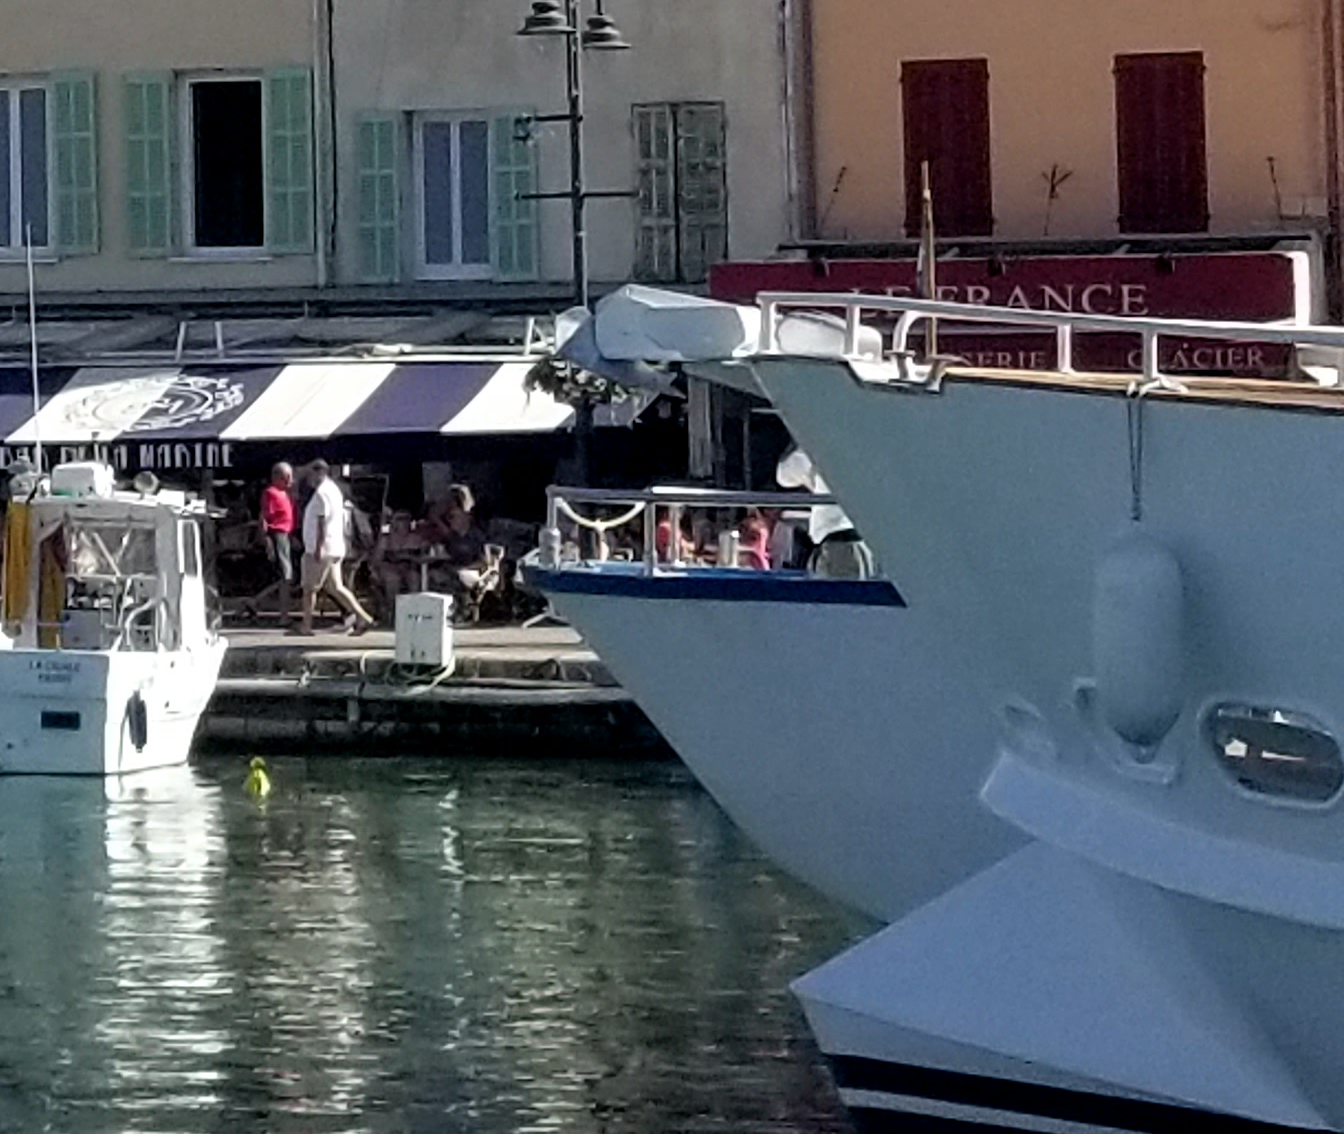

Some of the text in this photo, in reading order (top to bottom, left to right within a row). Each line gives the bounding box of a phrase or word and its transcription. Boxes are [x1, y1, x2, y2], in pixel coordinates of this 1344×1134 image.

[935, 283, 1150, 316] FRANCE
[1127, 347, 1263, 370] GACIER
[139, 443, 233, 468] MARINE
